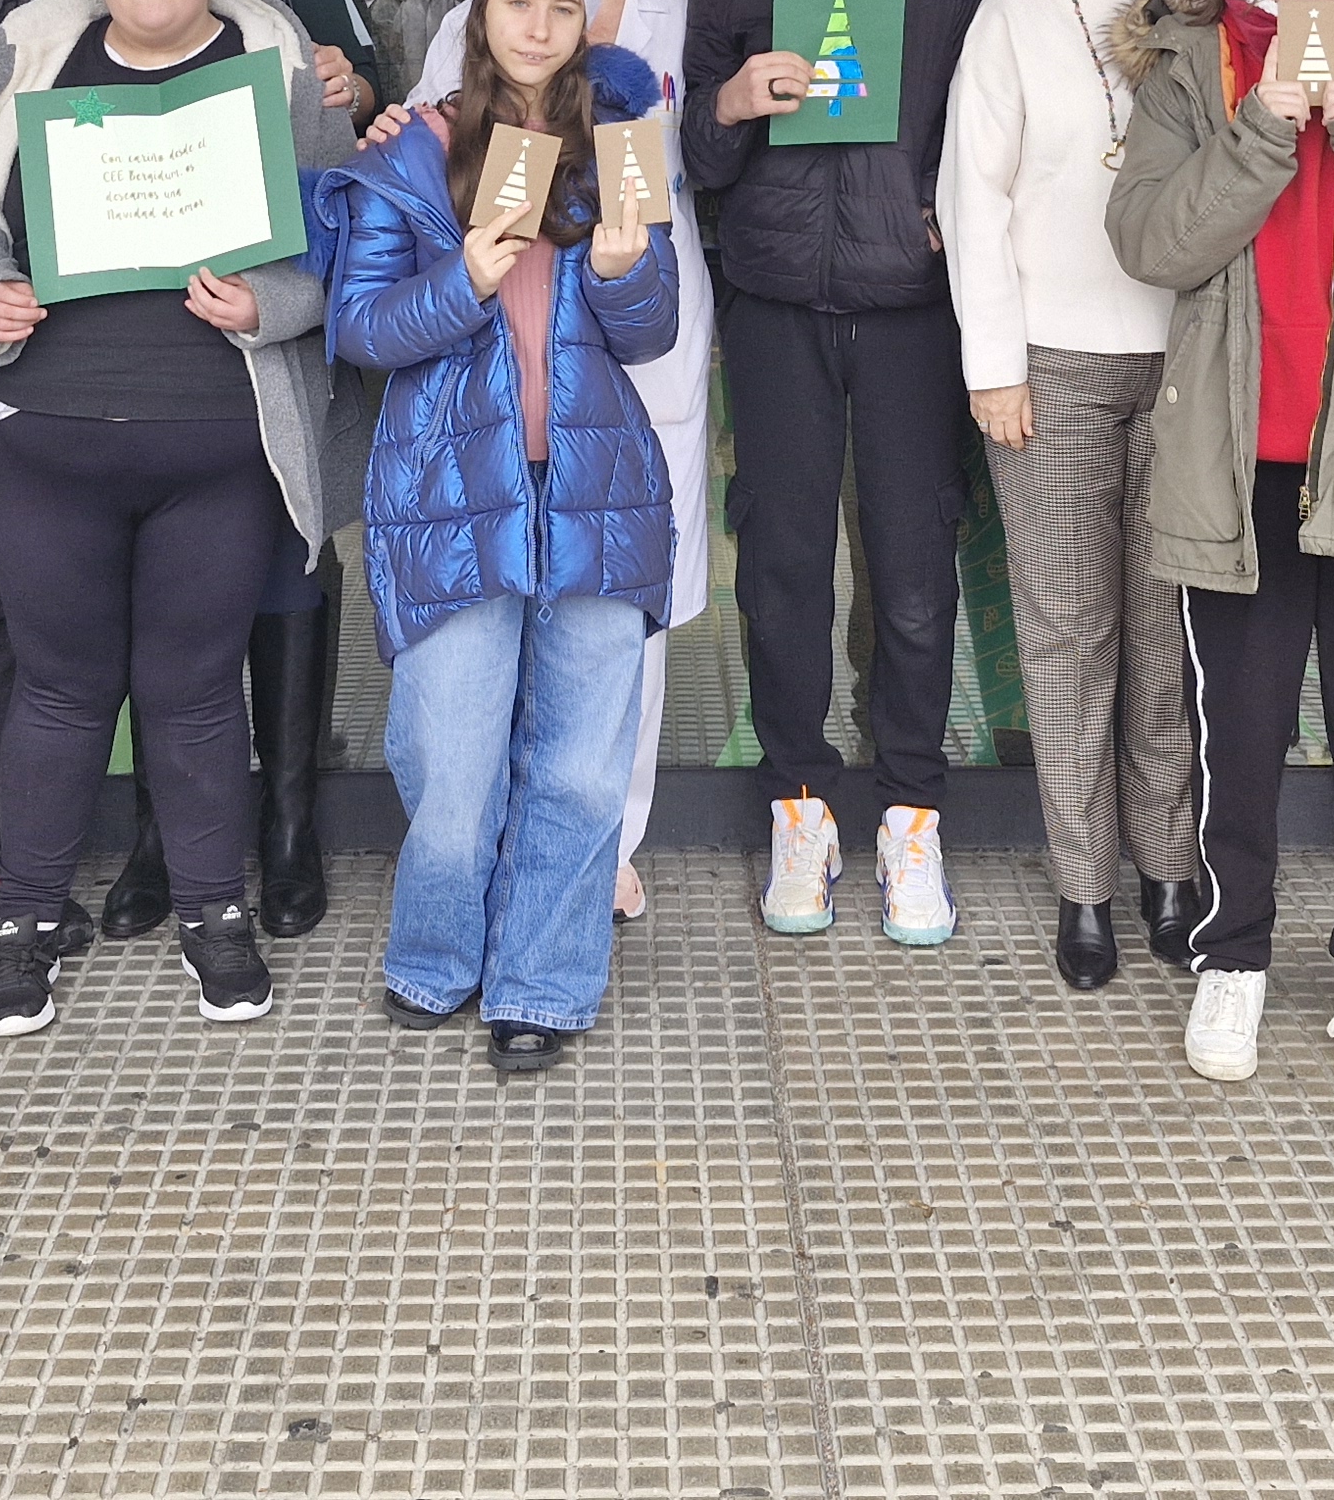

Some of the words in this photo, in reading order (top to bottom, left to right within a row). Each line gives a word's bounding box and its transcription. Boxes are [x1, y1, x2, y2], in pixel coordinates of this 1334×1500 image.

[101, 152, 123, 164] Con
[169, 143, 193, 161] desde
[198, 137, 207, 149] el
[103, 170, 124, 183] CEE
[106, 191, 159, 203] deseamos
[164, 188, 182, 199] una
[107, 207, 156, 221] Navidad
[163, 207, 174, 219] de
[179, 198, 204, 215] amor
